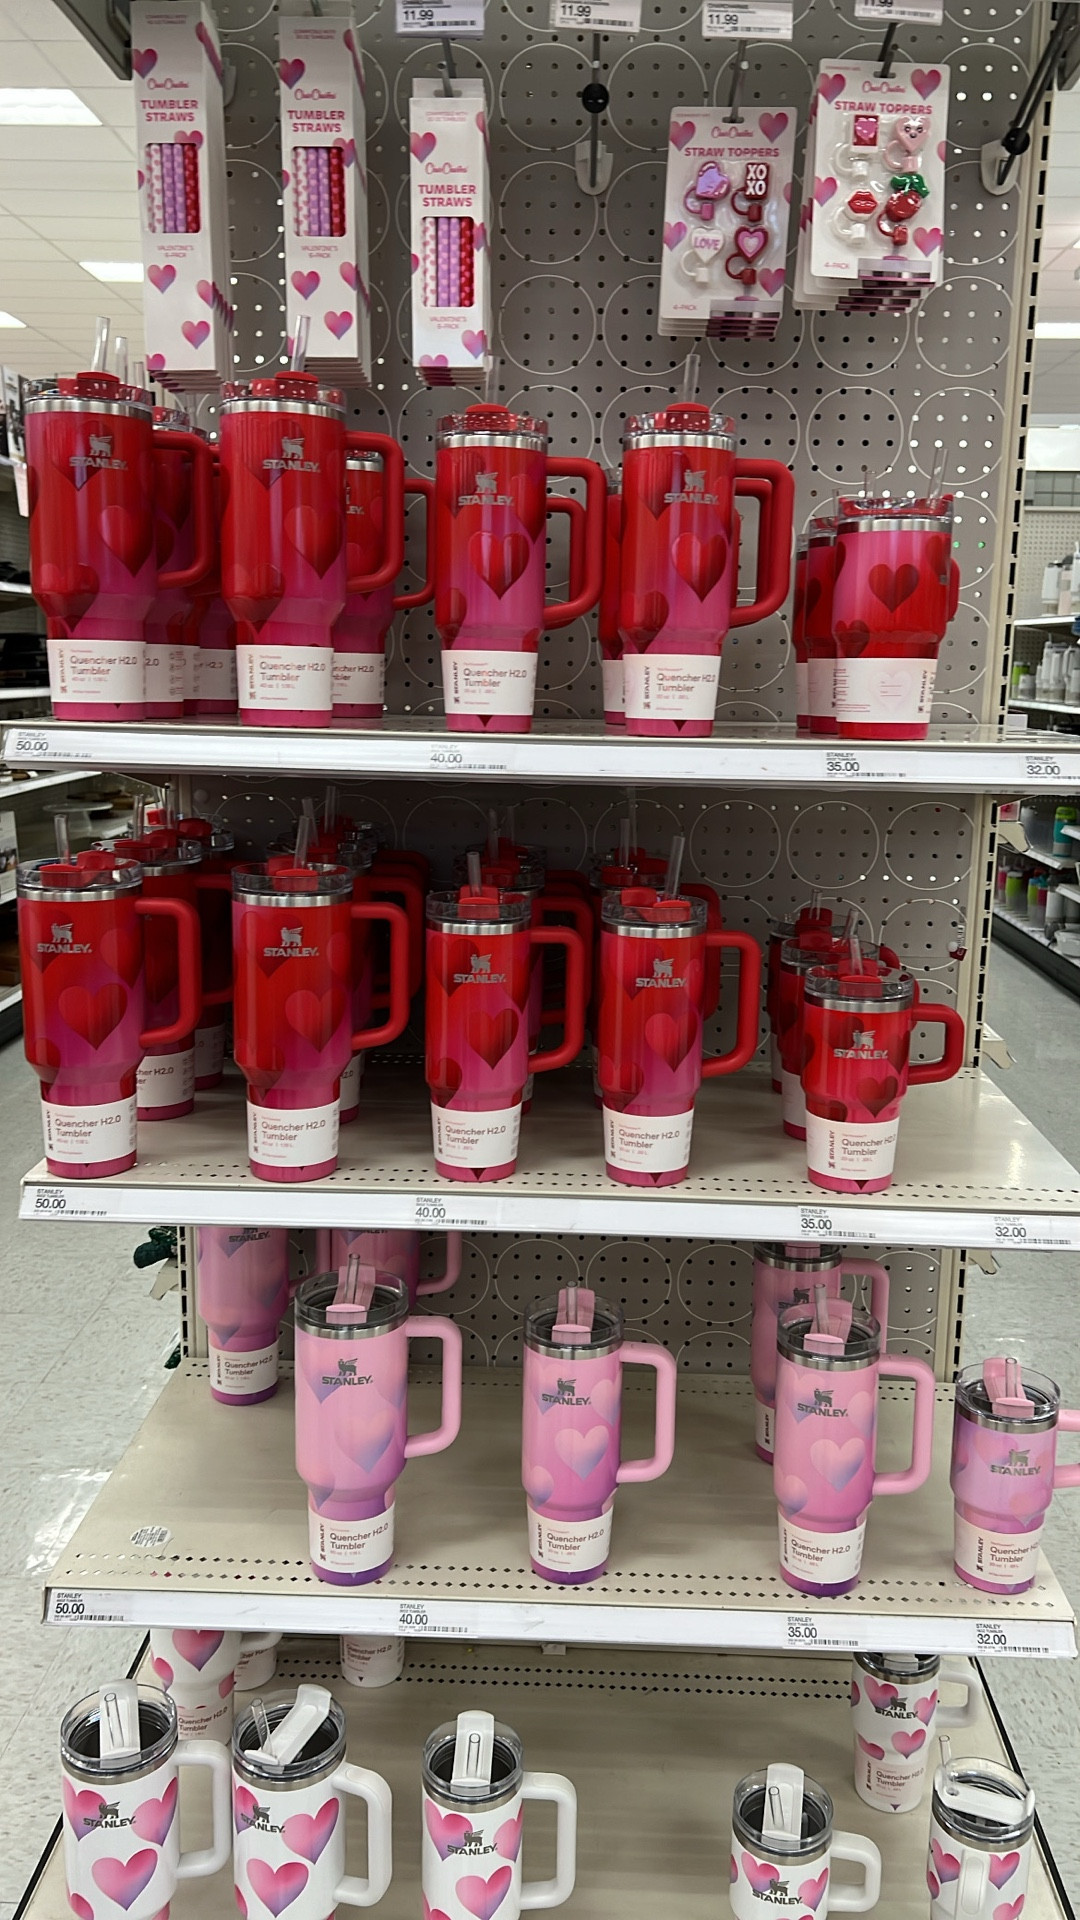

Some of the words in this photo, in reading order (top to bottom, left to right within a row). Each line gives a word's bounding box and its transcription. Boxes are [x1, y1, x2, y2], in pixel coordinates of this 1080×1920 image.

[403, 10, 433, 21] 11.99
[560, 5, 591, 17] 11.99
[708, 14, 738, 25] 11.99
[141, 100, 198, 109] TUMBLER
[834, 101, 876, 112] STRAW
[879, 103, 933, 115] TOPPERS
[145, 112, 195, 122] STRAWS
[287, 110, 345, 120] TUMBLER
[292, 123, 342, 133] STRAWS
[684, 147, 725, 157] STRAW
[728, 148, 780, 157] TOPPERS
[746, 164, 768, 180] XO
[418, 184, 477, 194] TUMBLER
[745, 180, 767, 196] XO
[422, 197, 472, 207] STRAWS
[693, 236, 721, 249] LOVE
[69, 456, 127, 471] STANLEY
[263, 459, 320, 473] STANLEY
[458, 495, 514, 506] STANLEY
[664, 493, 719, 505] STANLEY
[70, 656, 117, 666] Quencher
[118, 656, 137, 665] H2.0
[259, 661, 306, 671] Quencher
[307, 663, 326, 672] H2.0
[71, 667, 111, 676] Tumbler
[259, 672, 300, 681] Tumbler
[464, 668, 508, 677] Quencher
[509, 669, 527, 678] H2.0
[464, 678, 501, 687] Tumbler
[657, 673, 701, 682] Quencher
[657, 683, 695, 692] Tumbler
[16, 740, 48, 751] 50.00
[430, 753, 462, 763] 40.00
[827, 761, 859, 771] 35.00
[1026, 765, 1060, 775] 32.00
[37, 943, 92, 954] STANLEY
[264, 947, 319, 957] STANLEY
[453, 973, 506, 983] STANLEY
[635, 977, 687, 988] STANLEY
[833, 1048, 888, 1060] STANLEY
[154, 1066, 174, 1076] H2.0
[55, 1118, 99, 1128] Quencher
[100, 1115, 121, 1126] H2.0
[261, 1121, 304, 1132] Quencher
[305, 1119, 326, 1130] H2.0
[56, 1128, 92, 1137] Tumbler
[261, 1130, 297, 1141] Tumbler
[445, 1125, 485, 1136] Quencher
[486, 1125, 506, 1135] H2.0
[619, 1128, 660, 1140] Quencher
[661, 1130, 680, 1139] H2.0
[446, 1134, 479, 1144] Tumbler
[619, 1138, 653, 1148] Tumbler
[841, 1138, 883, 1147] Quencher
[842, 1147, 878, 1156] Tumbler
[35, 1198, 66, 1209] 50.00
[415, 1207, 446, 1218] 40.00
[800, 1217, 832, 1230] 35.00
[228, 1231, 271, 1243] STANLEY
[995, 1226, 1027, 1238] 32.00
[322, 1374, 373, 1386] STANLEY
[542, 1393, 591, 1405] STANLEY
[797, 1403, 848, 1417] STANLEY
[990, 1464, 1041, 1476] STANLEY
[329, 1532, 372, 1541] Quencher
[372, 1522, 389, 1537] H2.0
[546, 1532, 586, 1543] Quencher
[588, 1529, 604, 1541] H2.0
[330, 1541, 366, 1550] Tumbler
[547, 1540, 581, 1551] Tumbler
[791, 1539, 830, 1554] Quencher
[831, 1545, 851, 1554] H2.0
[990, 1546, 1029, 1555] Quencher
[791, 1546, 824, 1562] Tumbler
[990, 1554, 1024, 1563] Tumbler
[55, 1603, 85, 1614] 50.00
[399, 1613, 428, 1625] 40.00
[787, 1626, 817, 1638] 35.00
[976, 1633, 1007, 1645] 32.00
[874, 1706, 919, 1719] STANLEY
[876, 1770, 910, 1780] Quencher
[876, 1776, 906, 1787] Tumbler
[83, 1815, 137, 1828] STANLEY
[240, 1812, 285, 1834] STANLEY
[447, 1843, 498, 1856] STANLEY
[752, 1889, 803, 1905] STANLEY
